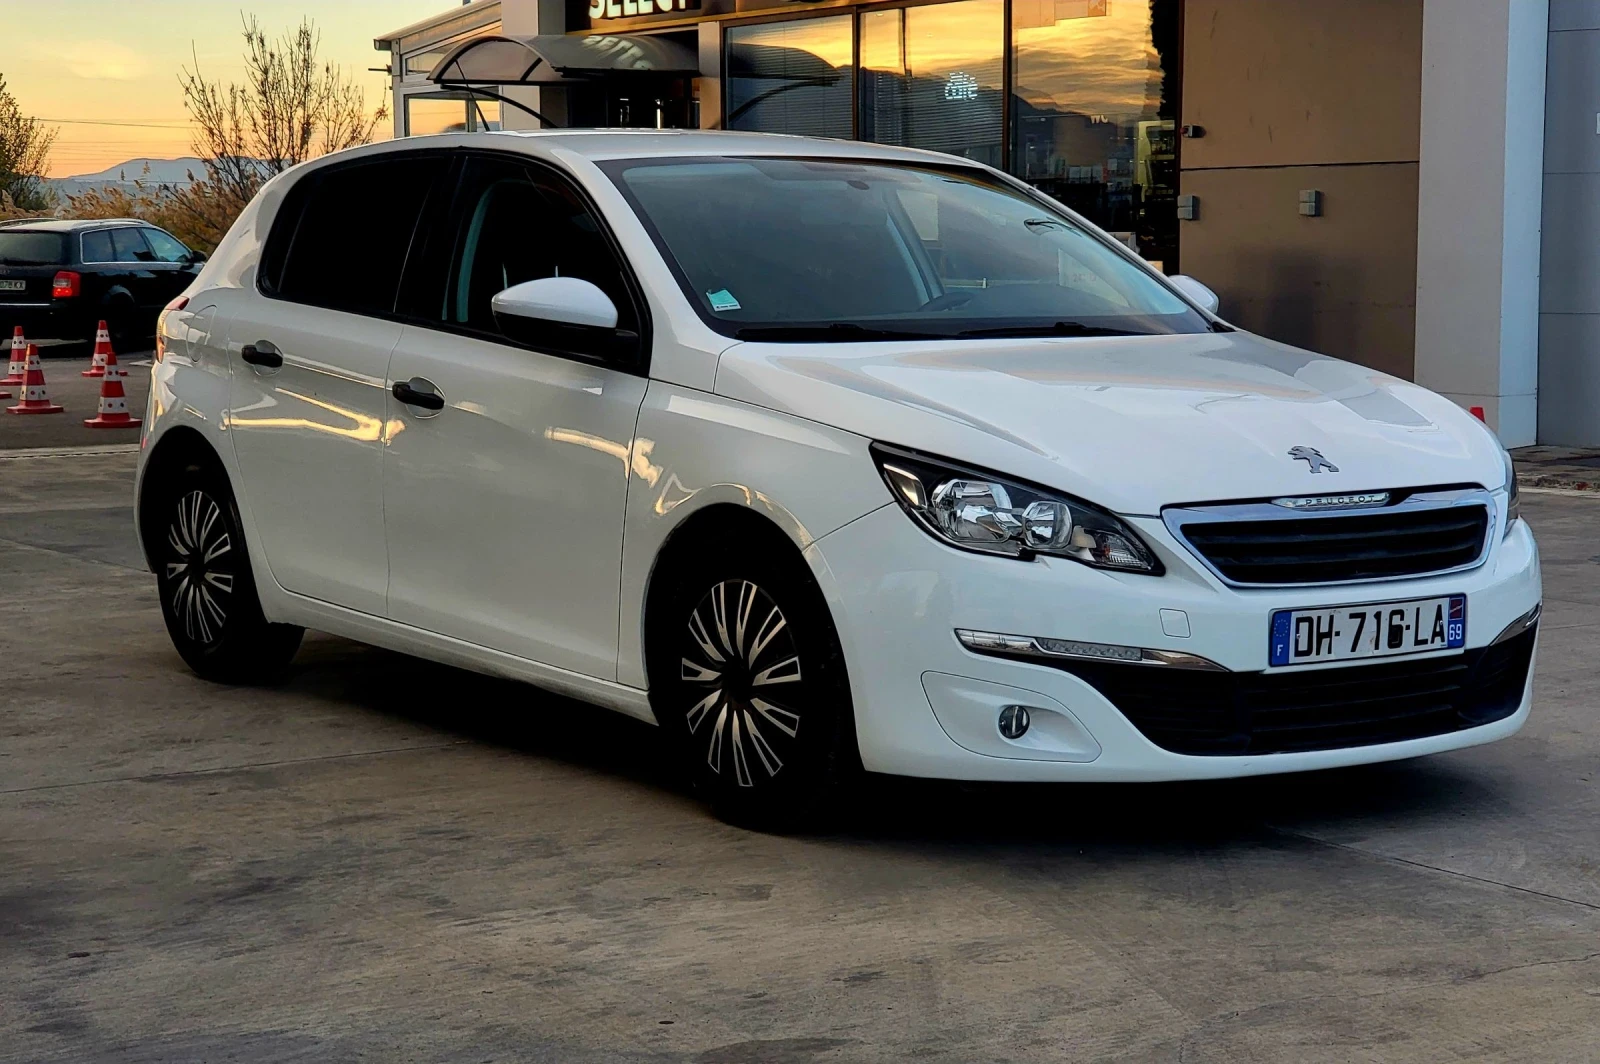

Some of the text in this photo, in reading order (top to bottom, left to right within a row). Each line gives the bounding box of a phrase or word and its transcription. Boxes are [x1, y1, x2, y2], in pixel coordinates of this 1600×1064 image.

[1305, 495, 1375, 506] PEUGEOT
[1448, 623, 1462, 641] 69
[1276, 644, 1284, 657] F
